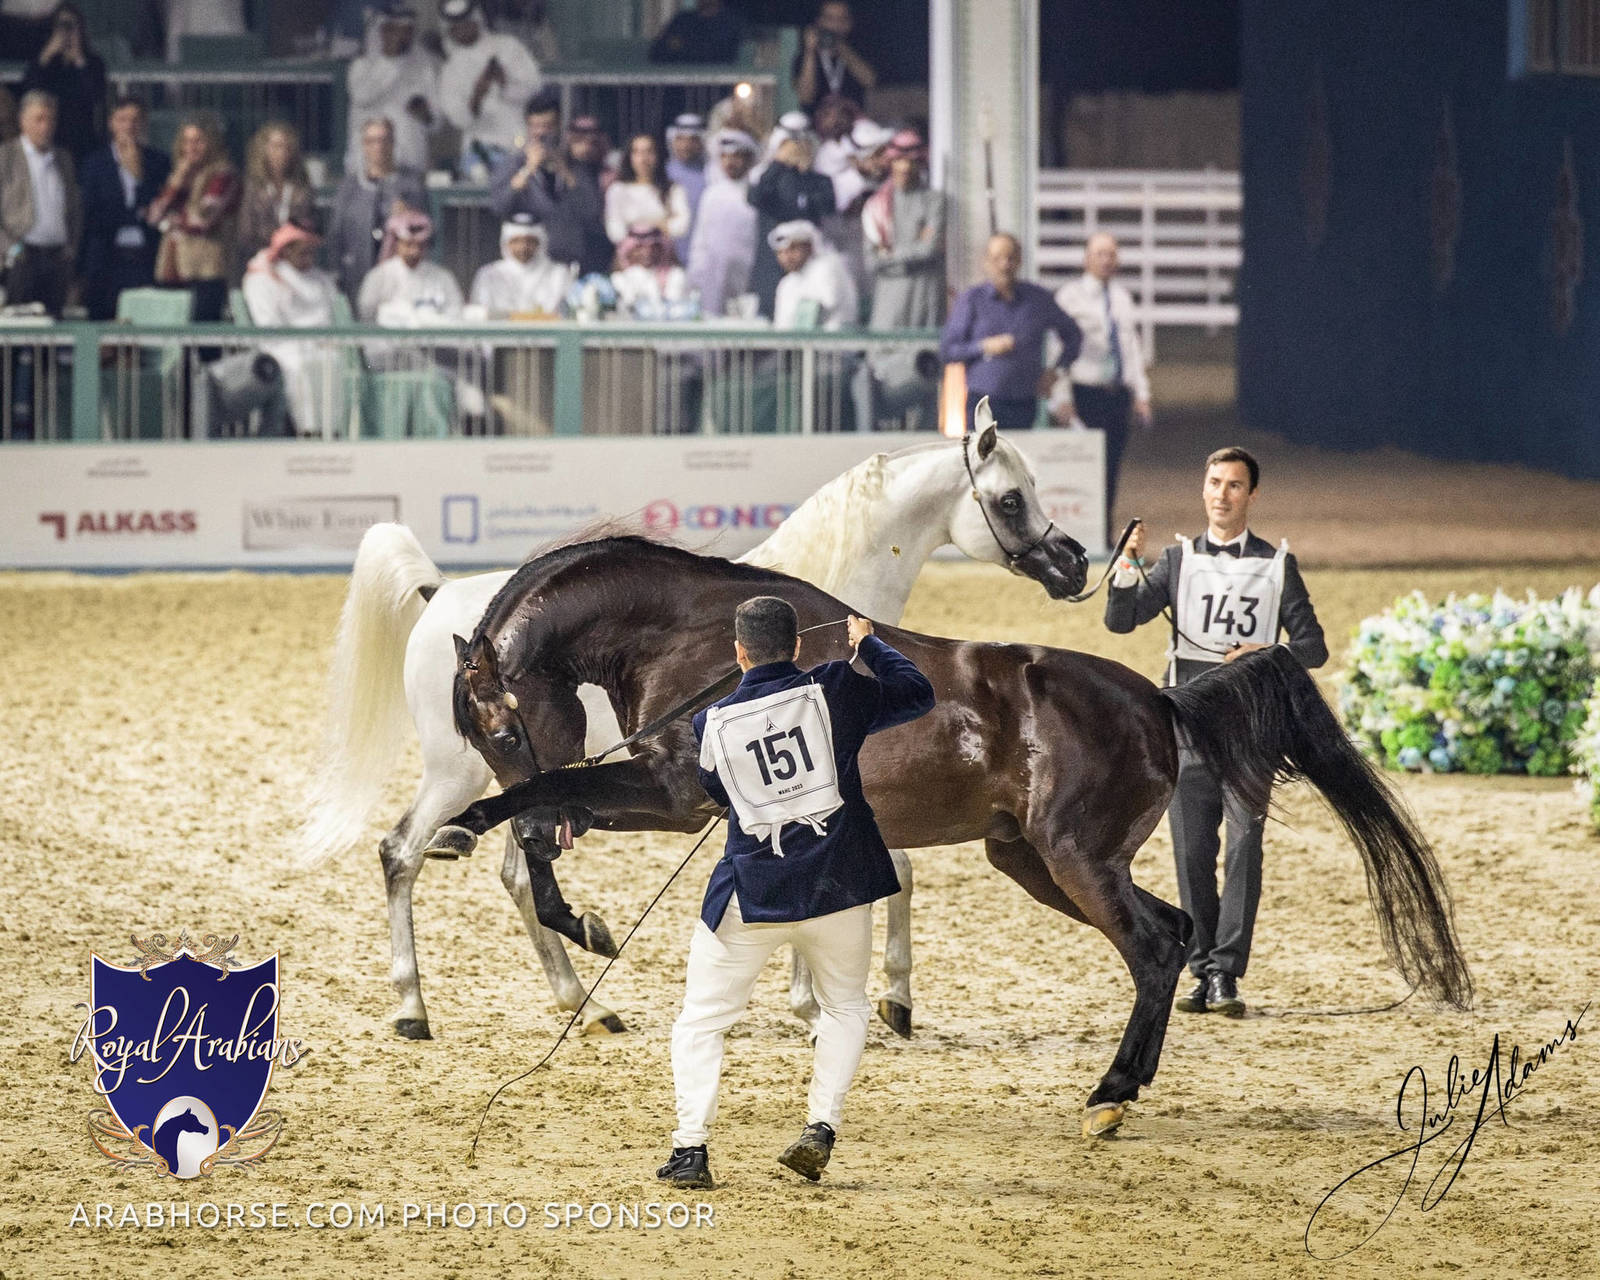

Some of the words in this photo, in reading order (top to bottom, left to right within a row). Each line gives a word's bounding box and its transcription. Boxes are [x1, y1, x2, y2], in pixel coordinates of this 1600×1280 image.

[77, 511, 197, 533] ALKASS
[1201, 594, 1260, 638] 143
[745, 725, 815, 786] 151
